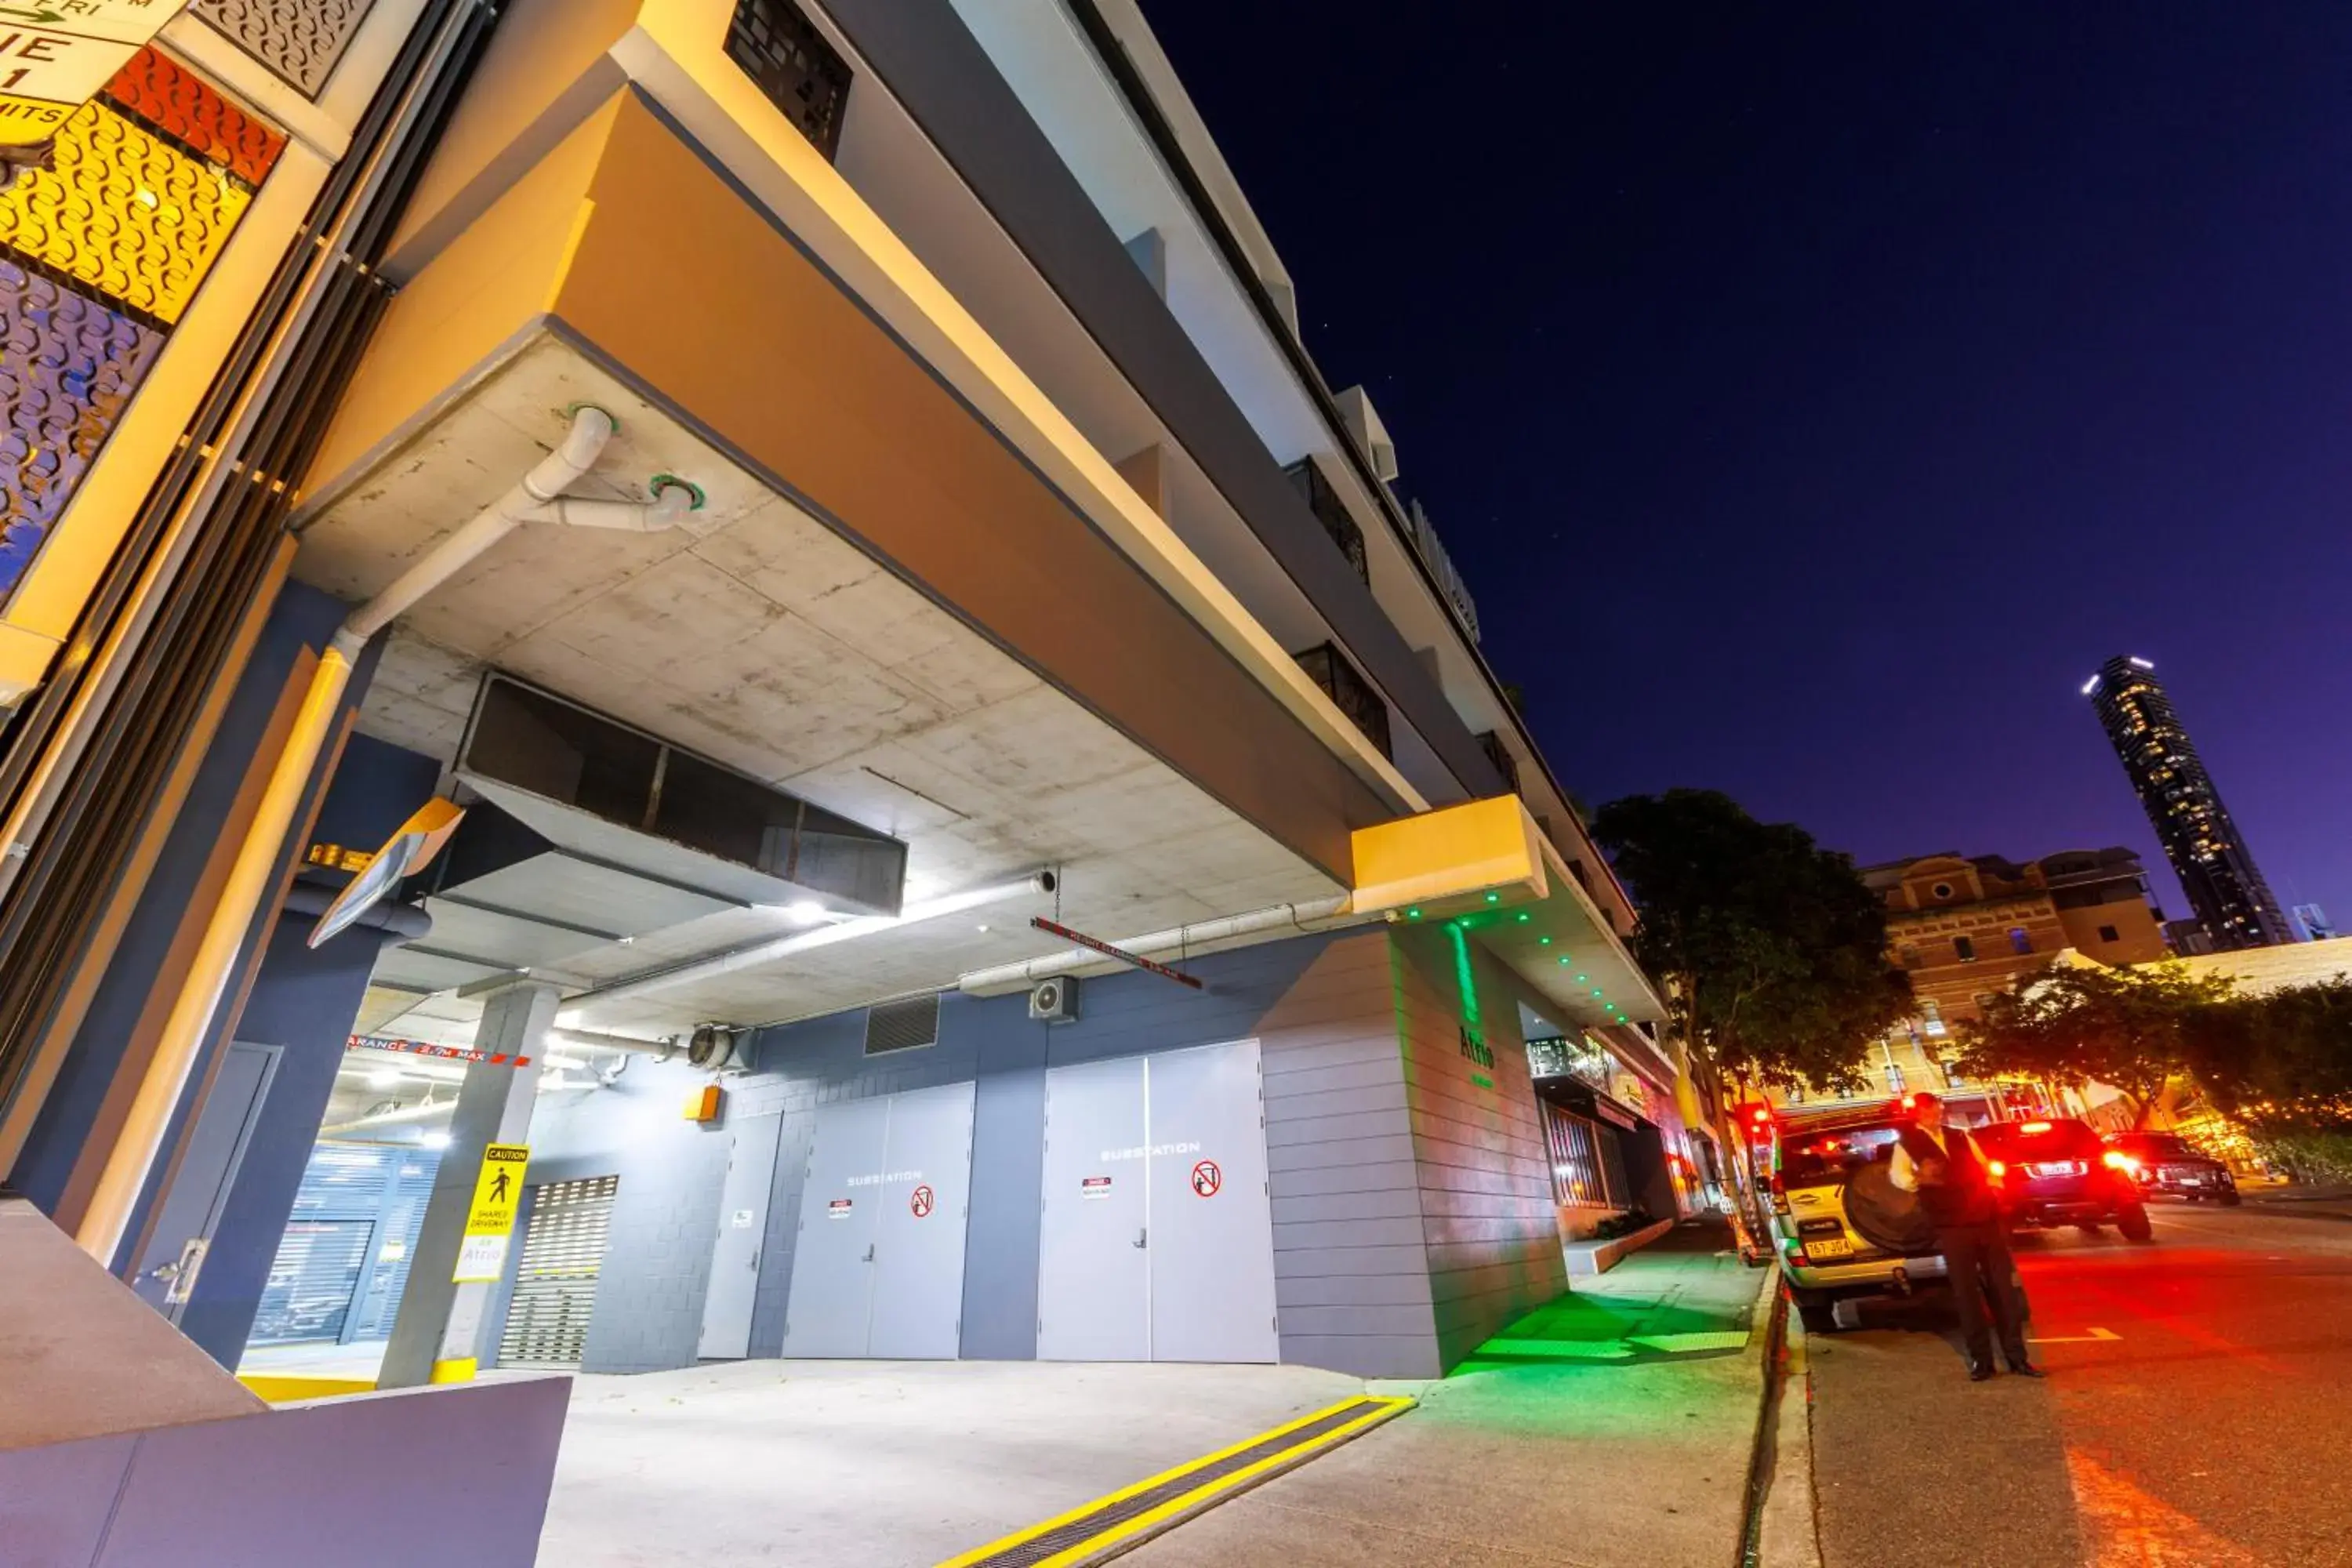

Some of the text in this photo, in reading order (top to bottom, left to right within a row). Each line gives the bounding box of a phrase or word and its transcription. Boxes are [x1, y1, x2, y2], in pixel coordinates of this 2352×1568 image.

[457, 1050, 485, 1062] MAX
[488, 1149, 526, 1160] CAUTION
[1100, 1142, 1201, 1162] SUBSTATION
[847, 1170, 923, 1187] SUBSTATION
